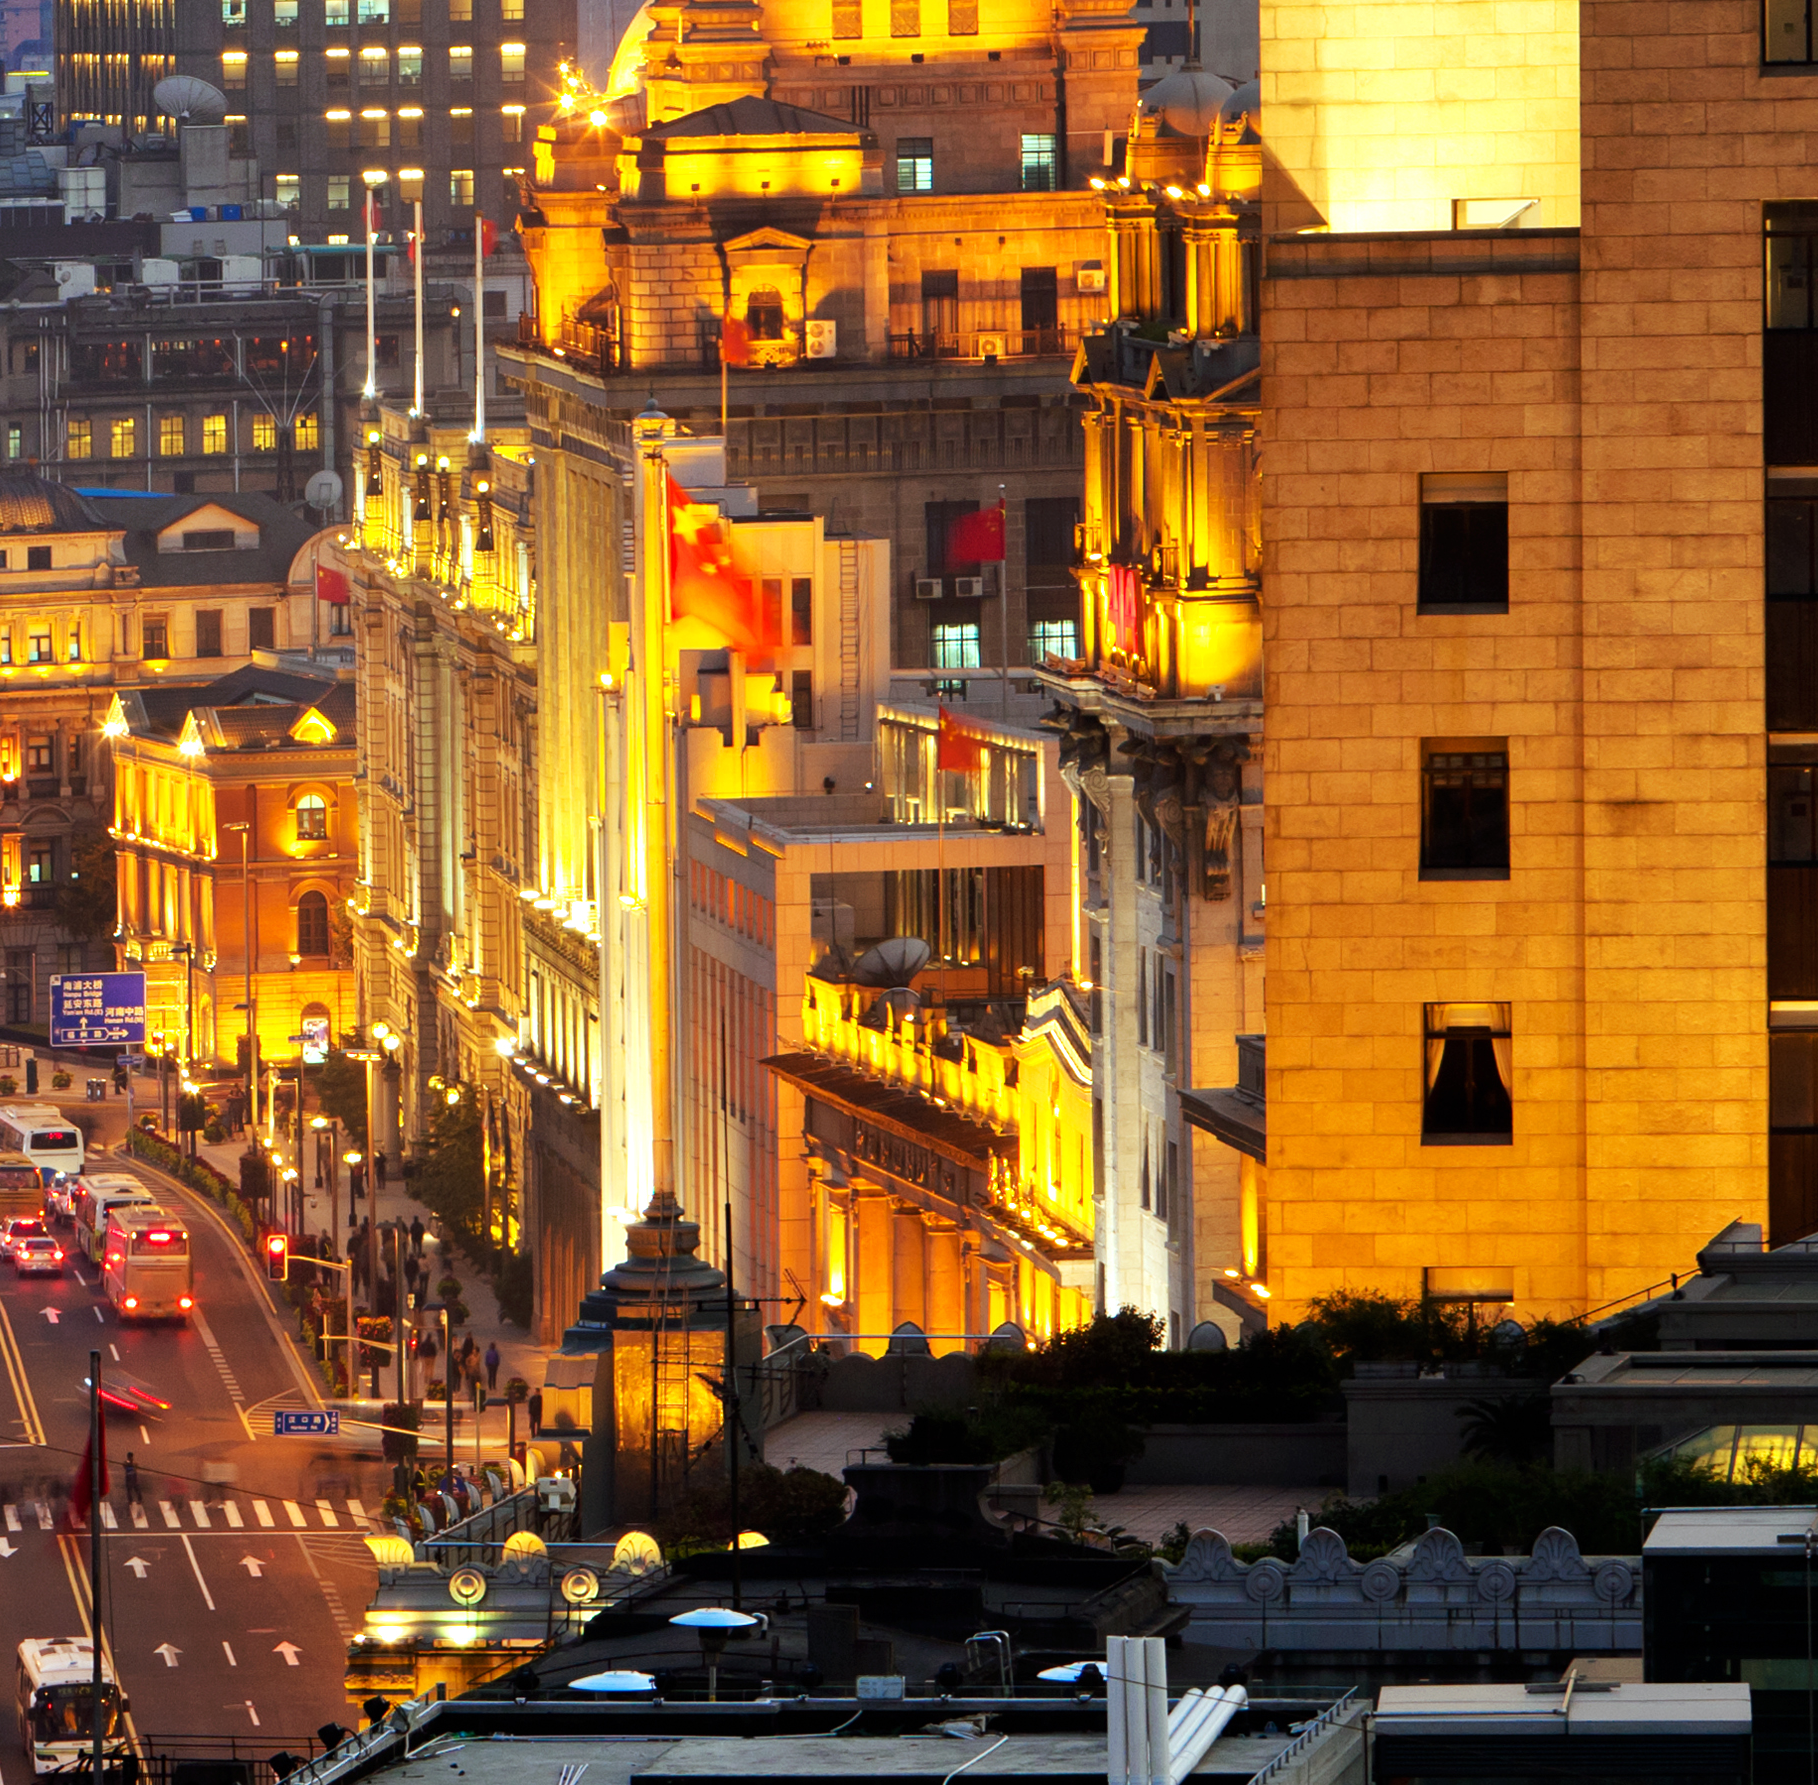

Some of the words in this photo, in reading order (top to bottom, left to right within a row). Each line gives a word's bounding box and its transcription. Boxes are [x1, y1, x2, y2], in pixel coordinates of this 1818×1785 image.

[63, 979, 103, 991] 南浦大桥
[63, 998, 103, 1009] 延安东路
[105, 1006, 144, 1017] 河南中路
